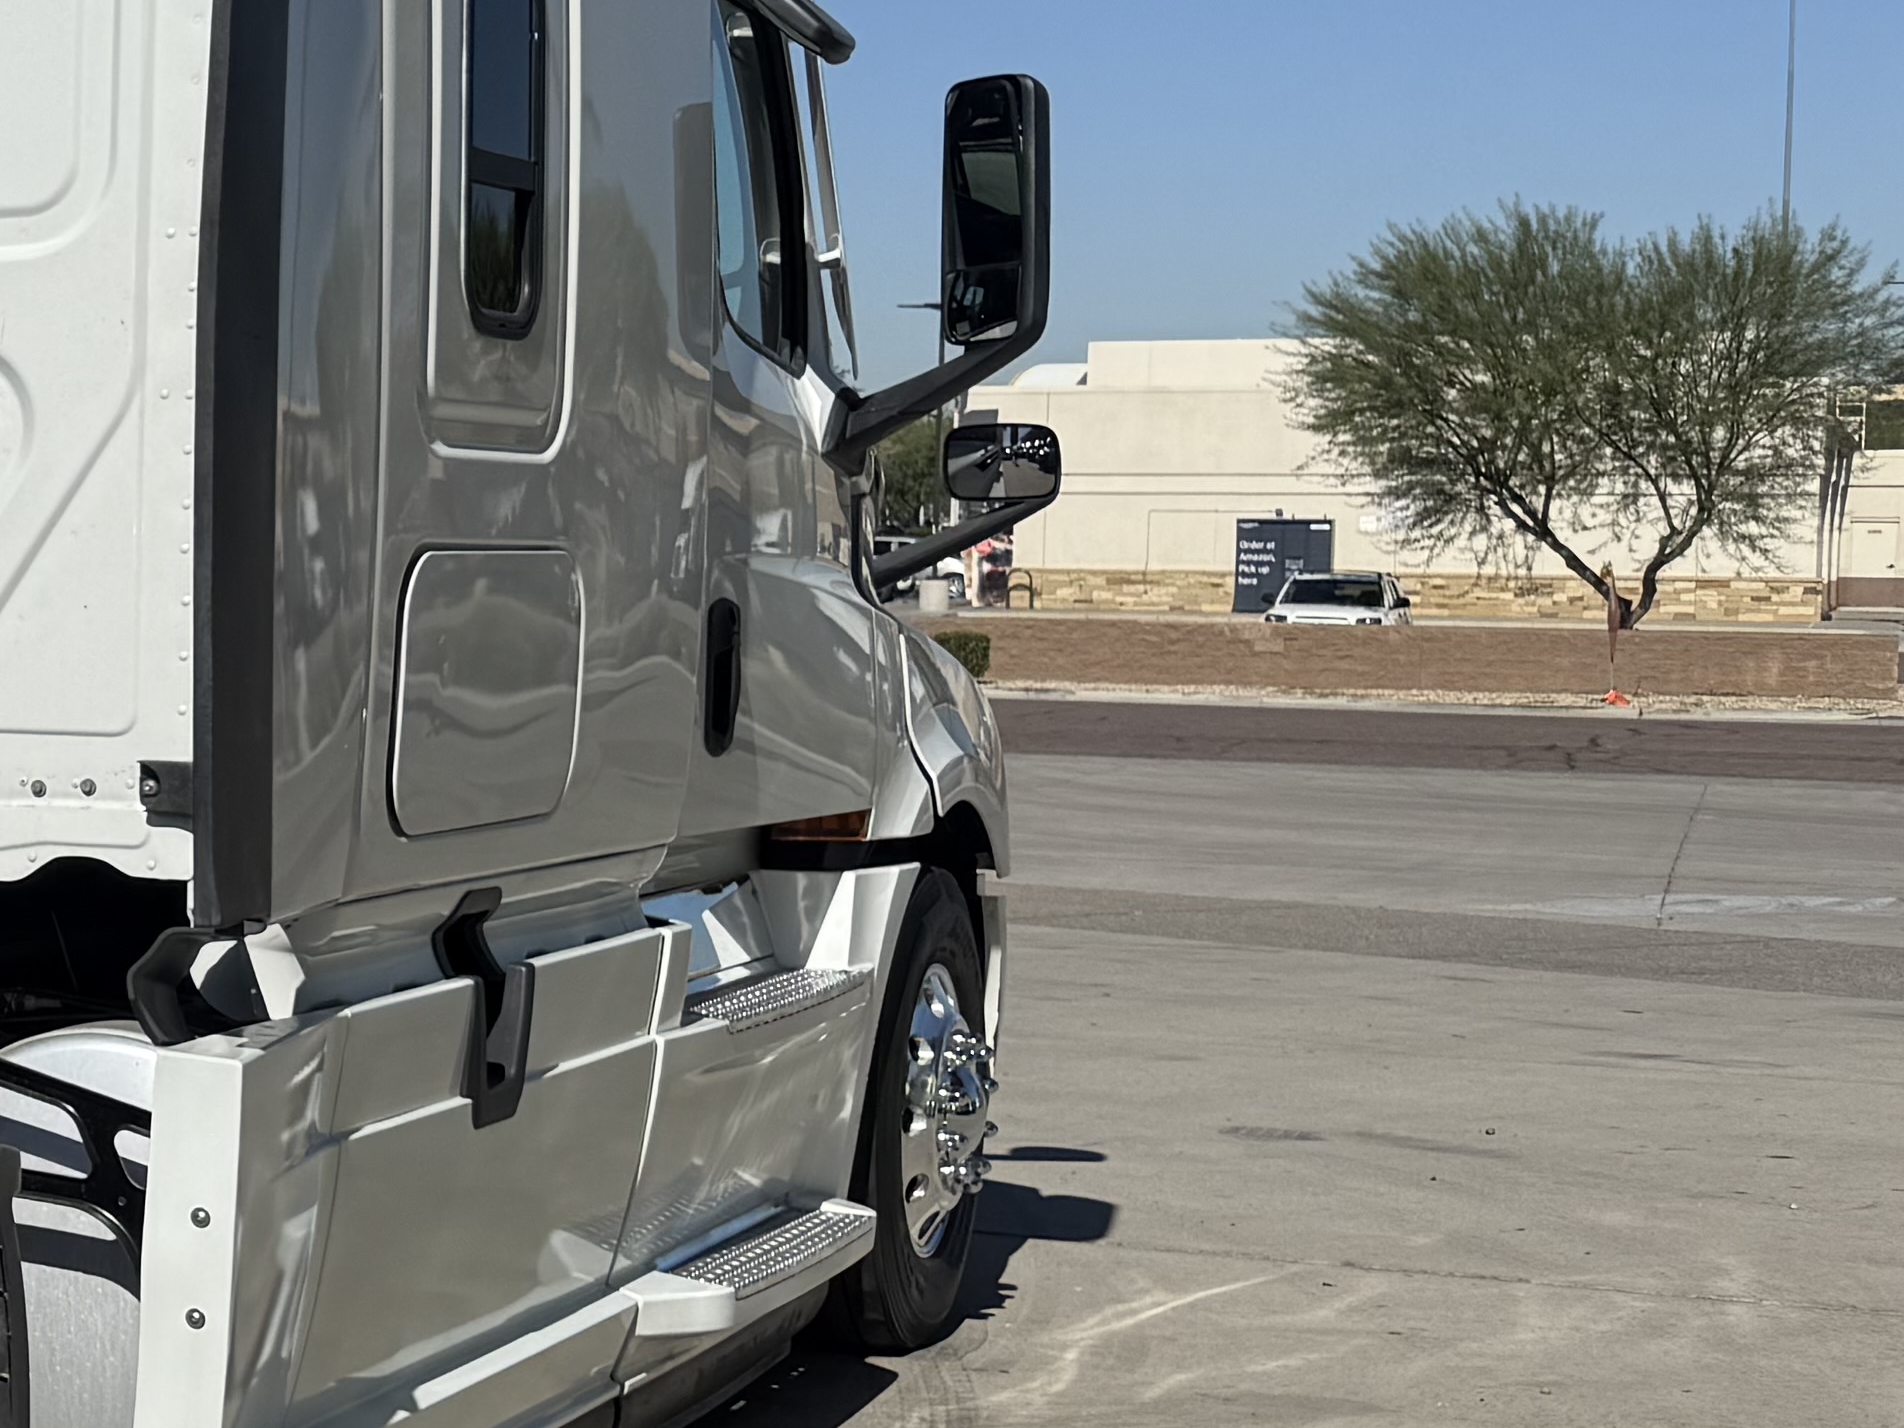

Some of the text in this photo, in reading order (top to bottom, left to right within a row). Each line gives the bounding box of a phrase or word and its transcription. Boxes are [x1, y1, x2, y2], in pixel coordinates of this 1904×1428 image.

[1239, 540, 1275, 550] Order at
[1238, 564, 1270, 575] Pick up
[1238, 576, 1257, 585] here
